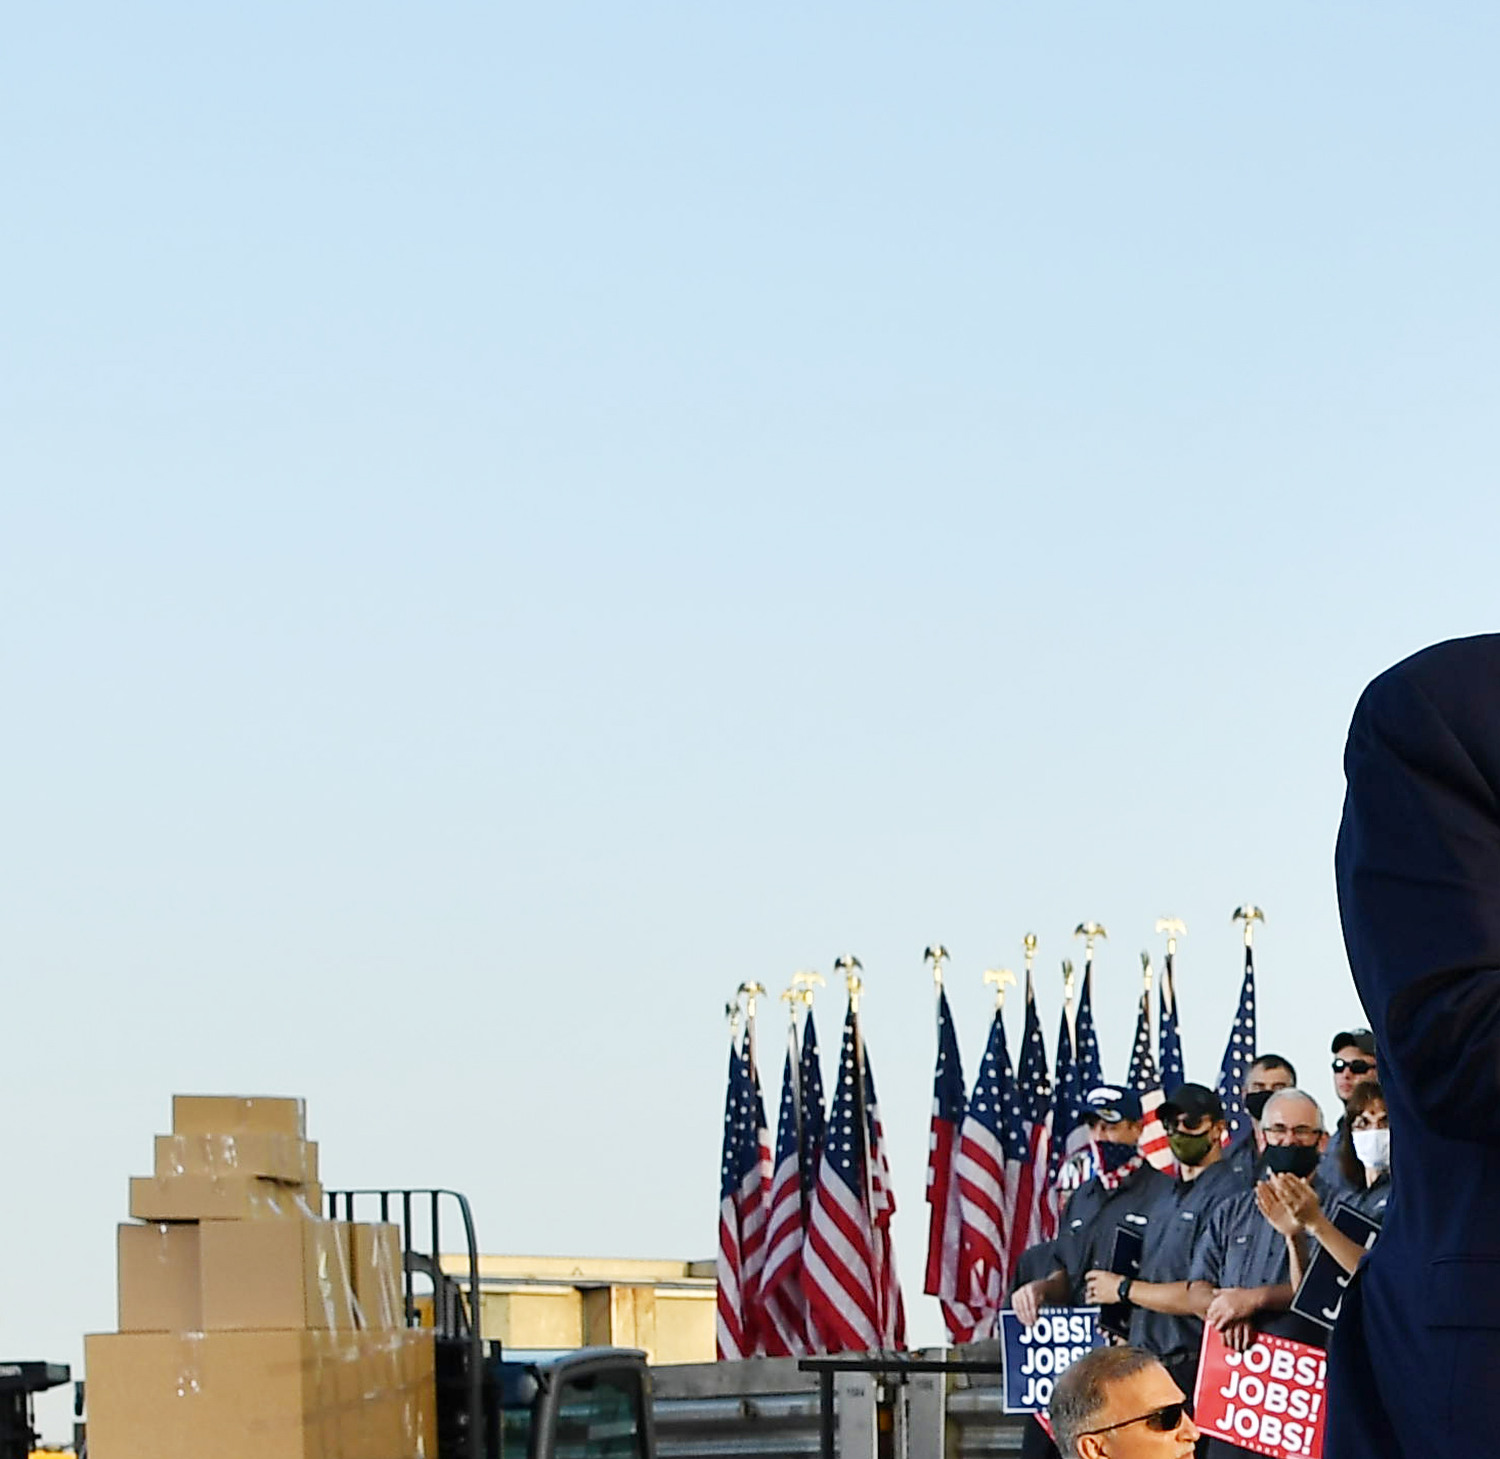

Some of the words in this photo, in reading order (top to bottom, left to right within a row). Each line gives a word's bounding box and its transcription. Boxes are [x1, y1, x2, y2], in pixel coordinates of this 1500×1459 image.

[1019, 1315, 1092, 1344] JOBS!
[1021, 1346, 1092, 1375] JOBS
[1225, 1343, 1327, 1389] JOBS!
[1219, 1370, 1321, 1422] JOBS!
[1215, 1403, 1315, 1455] JOBS!
